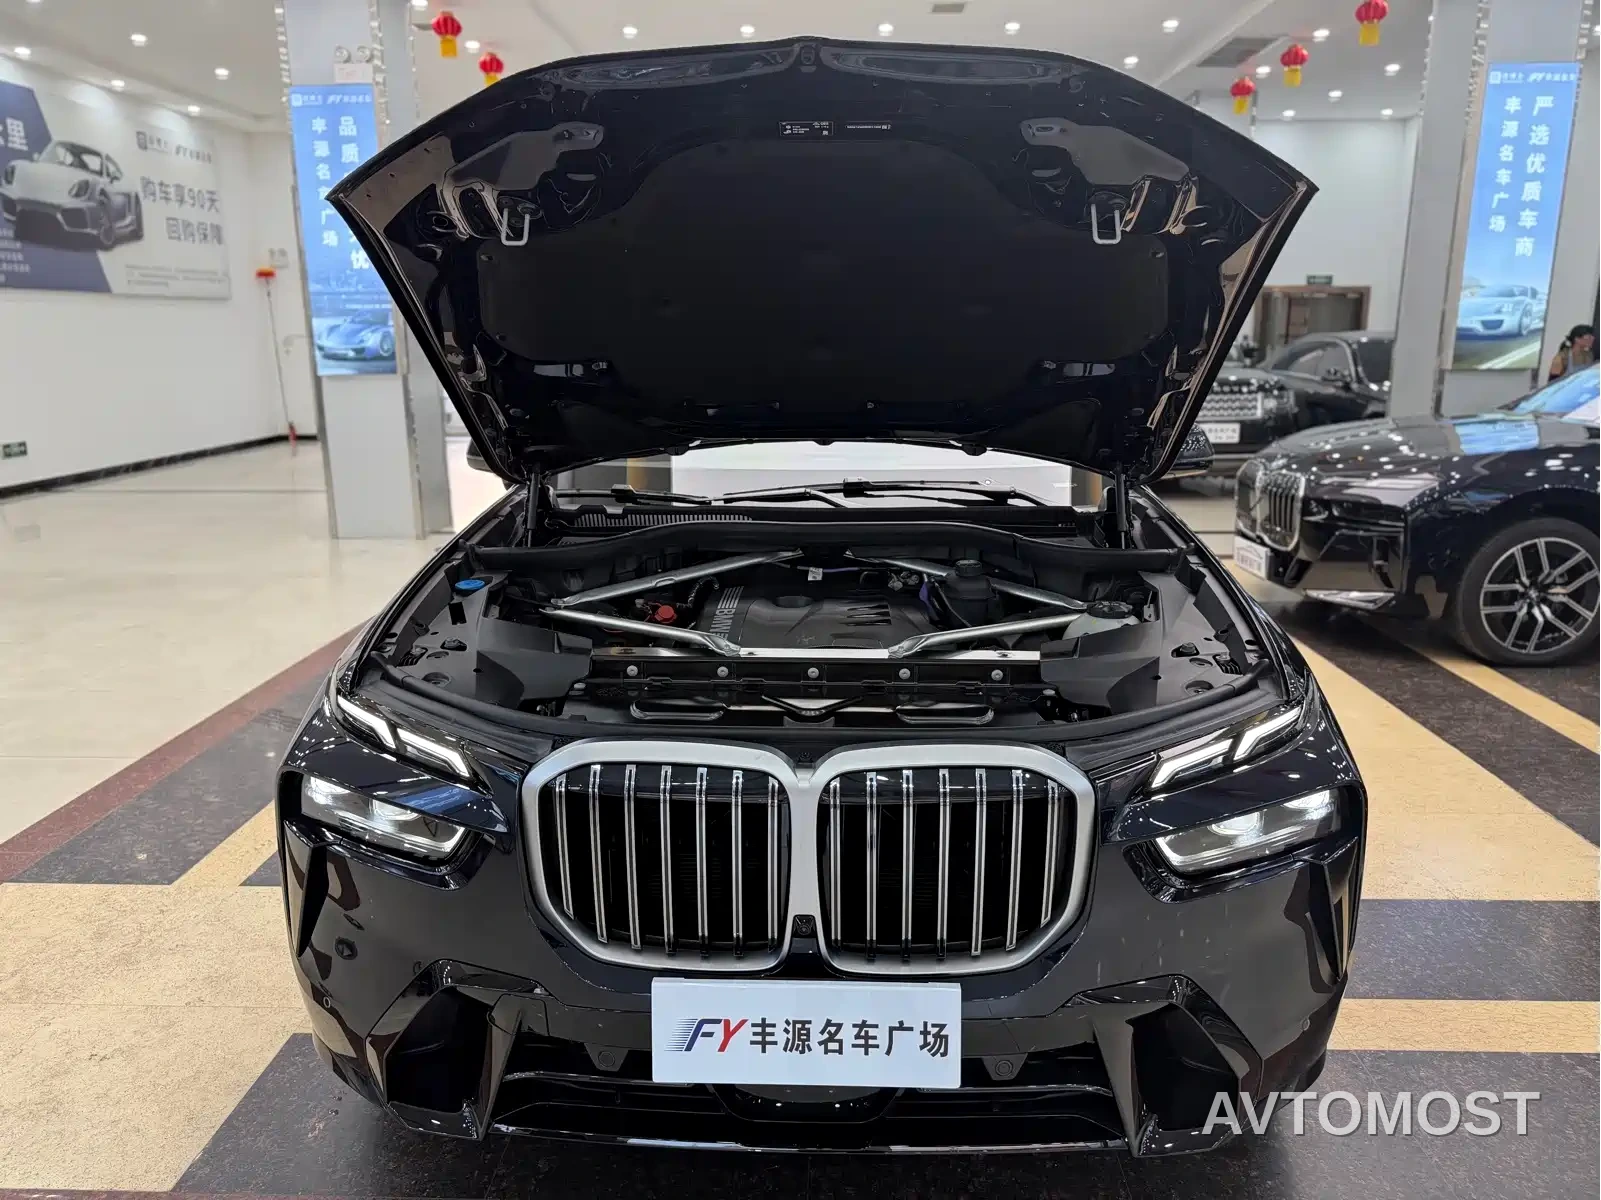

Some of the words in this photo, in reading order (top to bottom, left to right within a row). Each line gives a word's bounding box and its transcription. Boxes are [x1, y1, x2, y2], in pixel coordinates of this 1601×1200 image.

[1489, 96, 1522, 233] 丰源名车广场
[1515, 96, 1554, 257] 严选优质车商
[140, 176, 220, 212] 购车享90天
[166, 217, 223, 245] 回购保障
[710, 609, 735, 632] BMW
